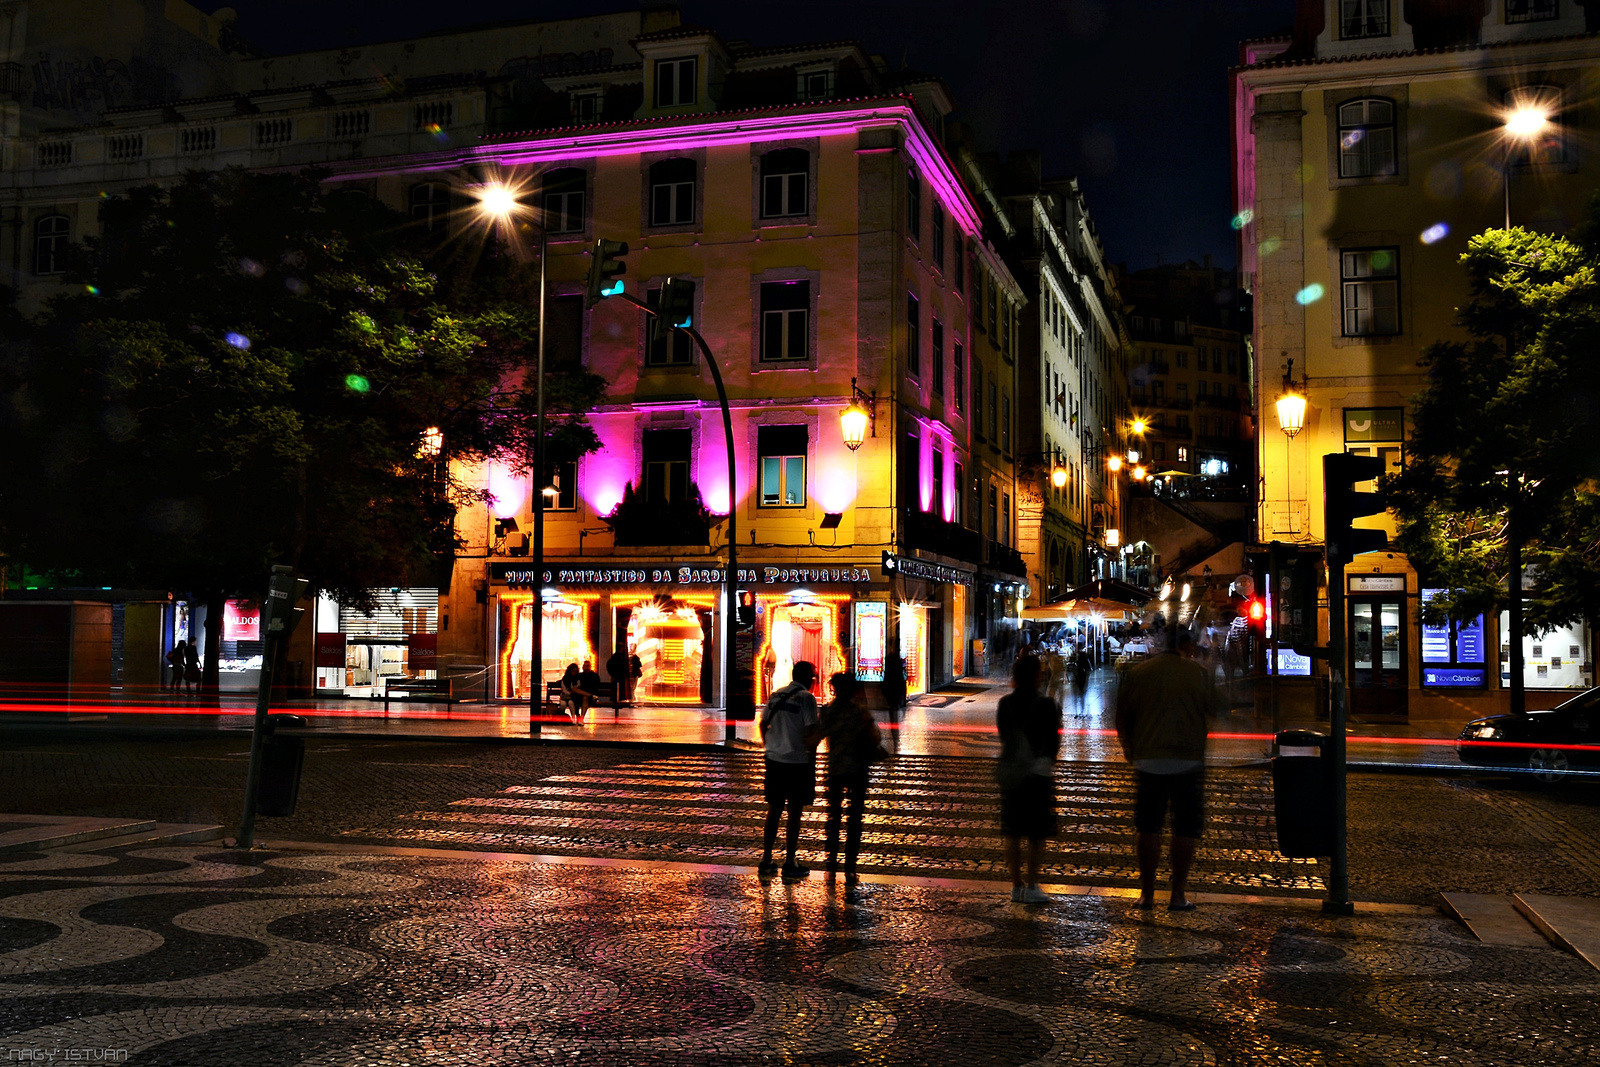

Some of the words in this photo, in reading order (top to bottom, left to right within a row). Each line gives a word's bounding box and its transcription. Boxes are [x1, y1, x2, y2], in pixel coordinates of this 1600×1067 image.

[504, 570, 552, 583] MUNO
[652, 569, 672, 583] DA
[678, 566, 757, 584] SARDIHA
[764, 566, 870, 584] PORTUGUESA
[320, 646, 343, 654] Saldos
[411, 648, 435, 656] Saldos
[1284, 655, 1307, 663] Nova
